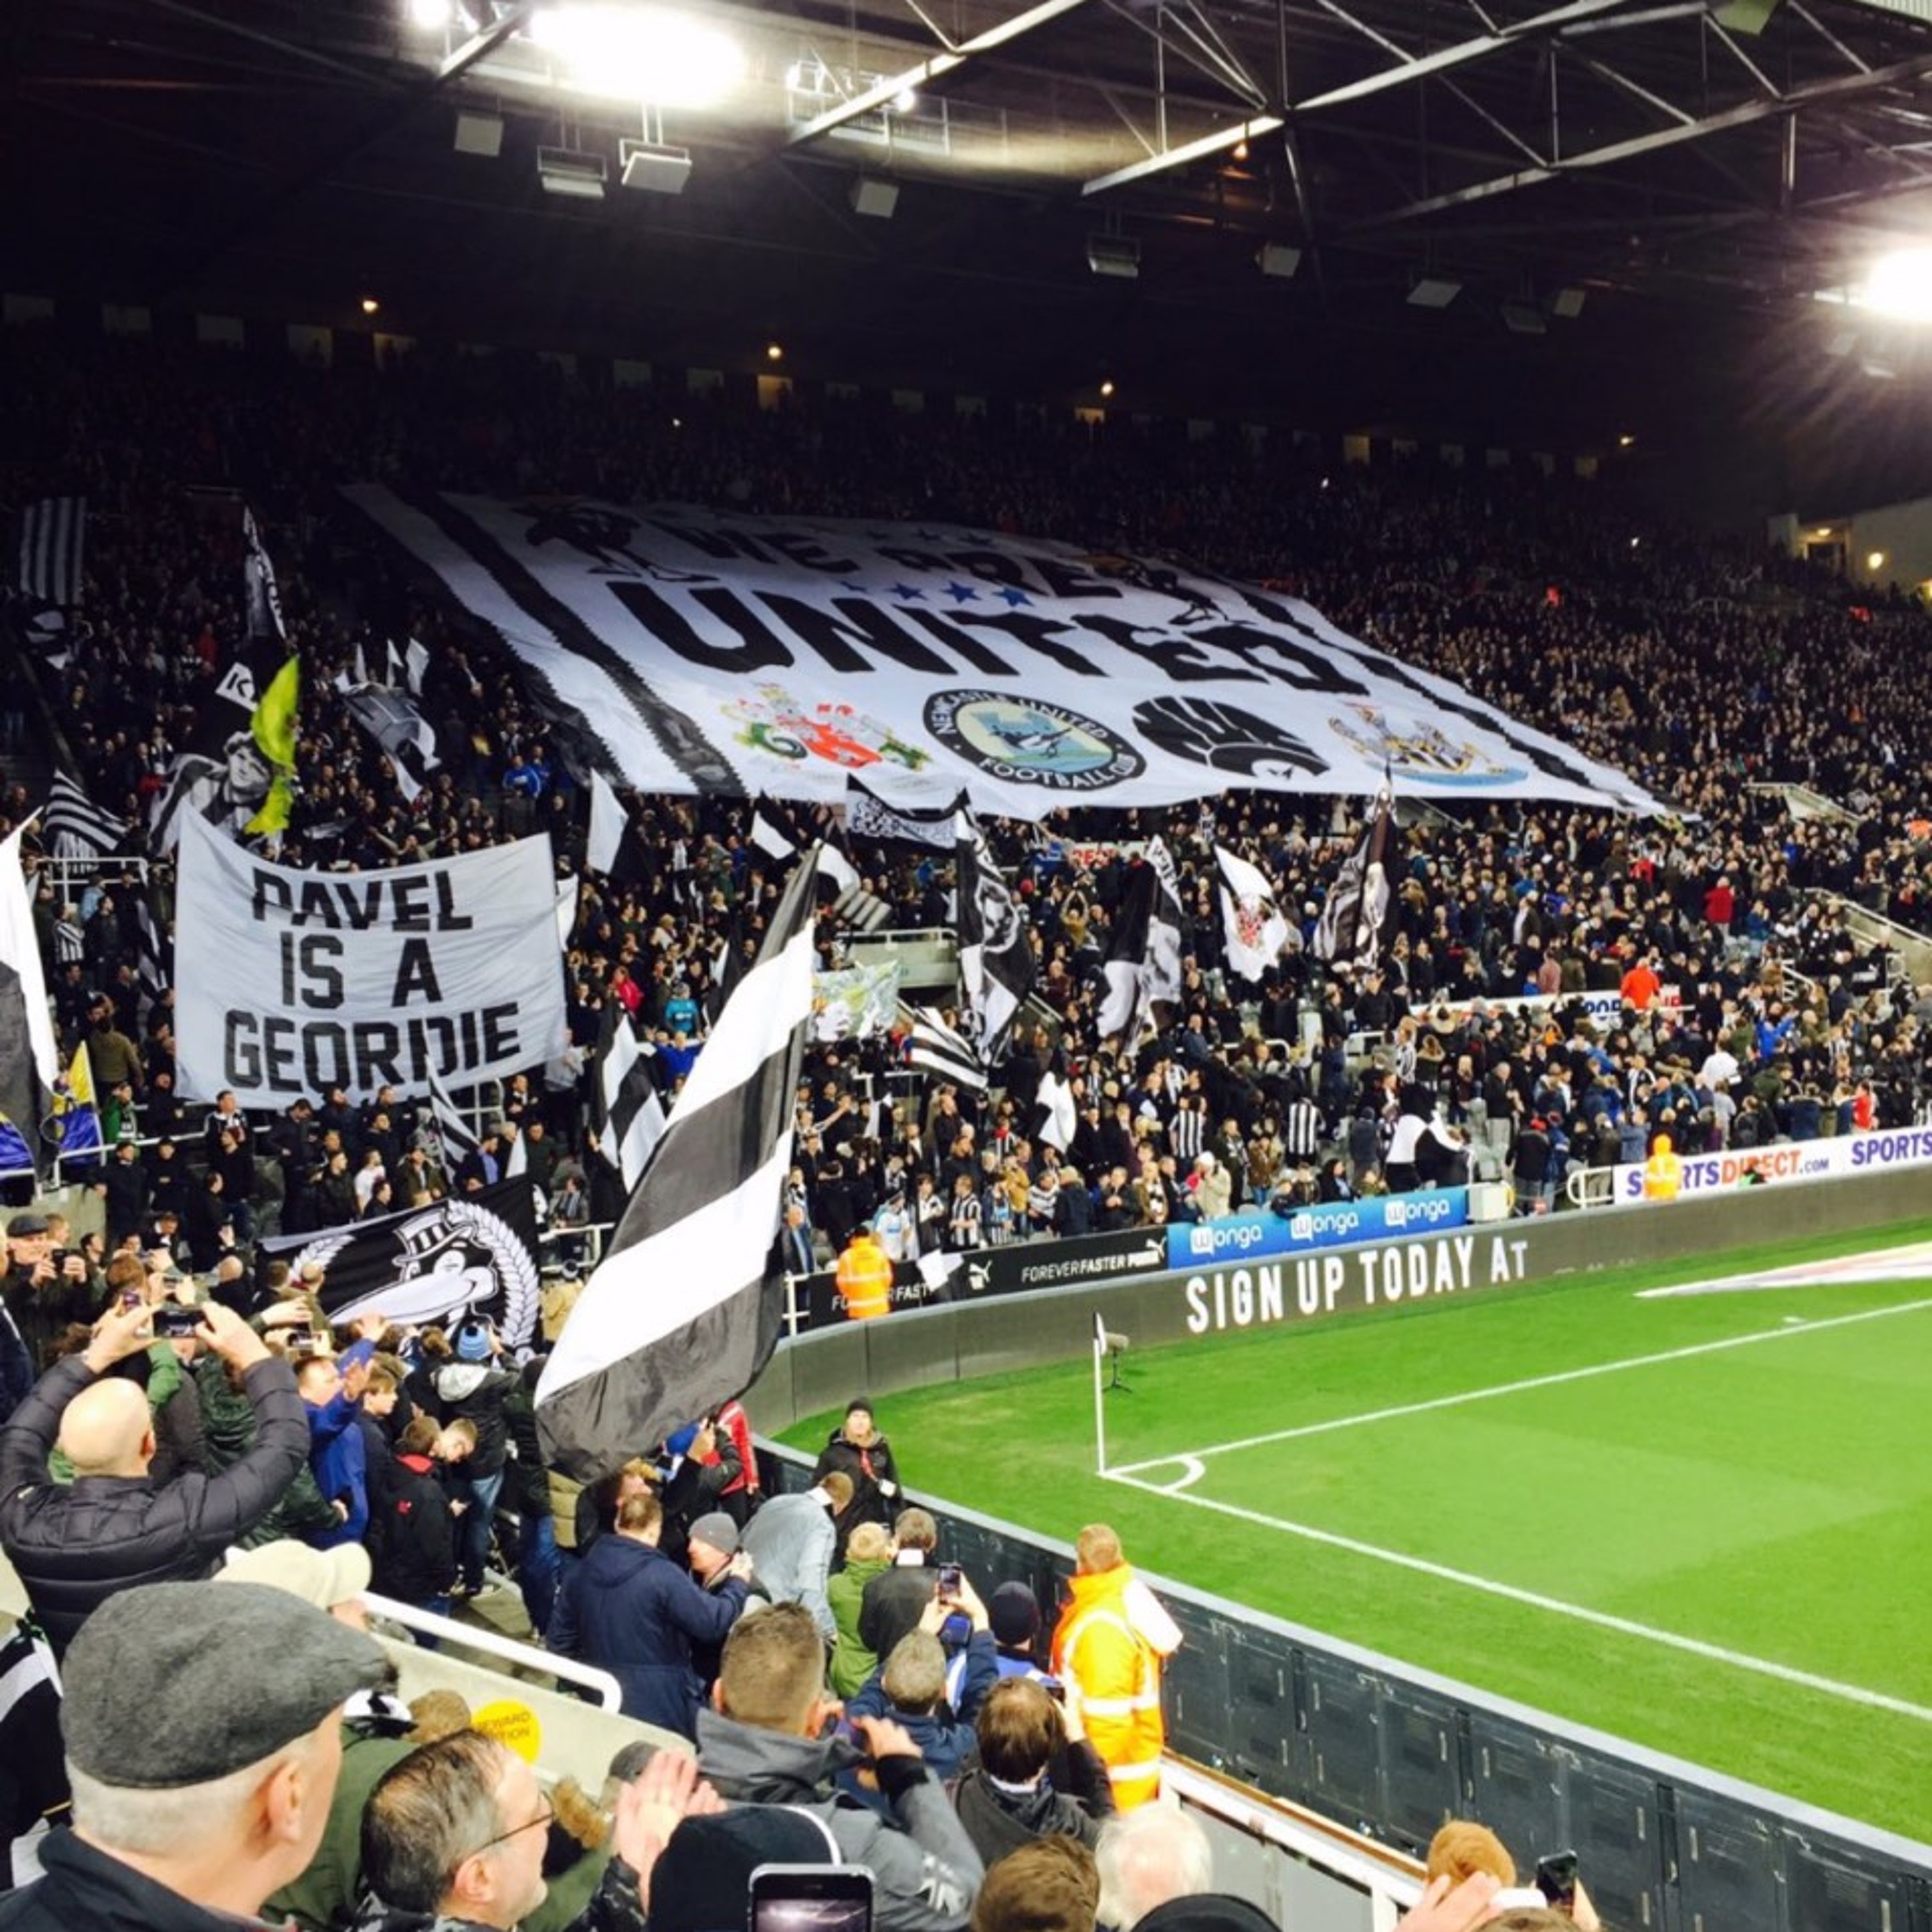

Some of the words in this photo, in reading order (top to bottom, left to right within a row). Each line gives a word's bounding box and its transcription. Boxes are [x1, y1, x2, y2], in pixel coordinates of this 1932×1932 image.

[649, 516, 860, 573] WE
[874, 546, 1122, 598] ARE
[607, 581, 1370, 696] UNITED
[980, 756, 1115, 788] FOOTBALL
[252, 867, 473, 932] PAVEL
[280, 931, 344, 1009] IS
[392, 938, 443, 1007] A
[224, 1003, 520, 1094] GEORDIE
[1186, 1265, 1283, 1333] SIGN
[1297, 1256, 1345, 1315] UP
[1359, 1236, 1475, 1304] TODAY
